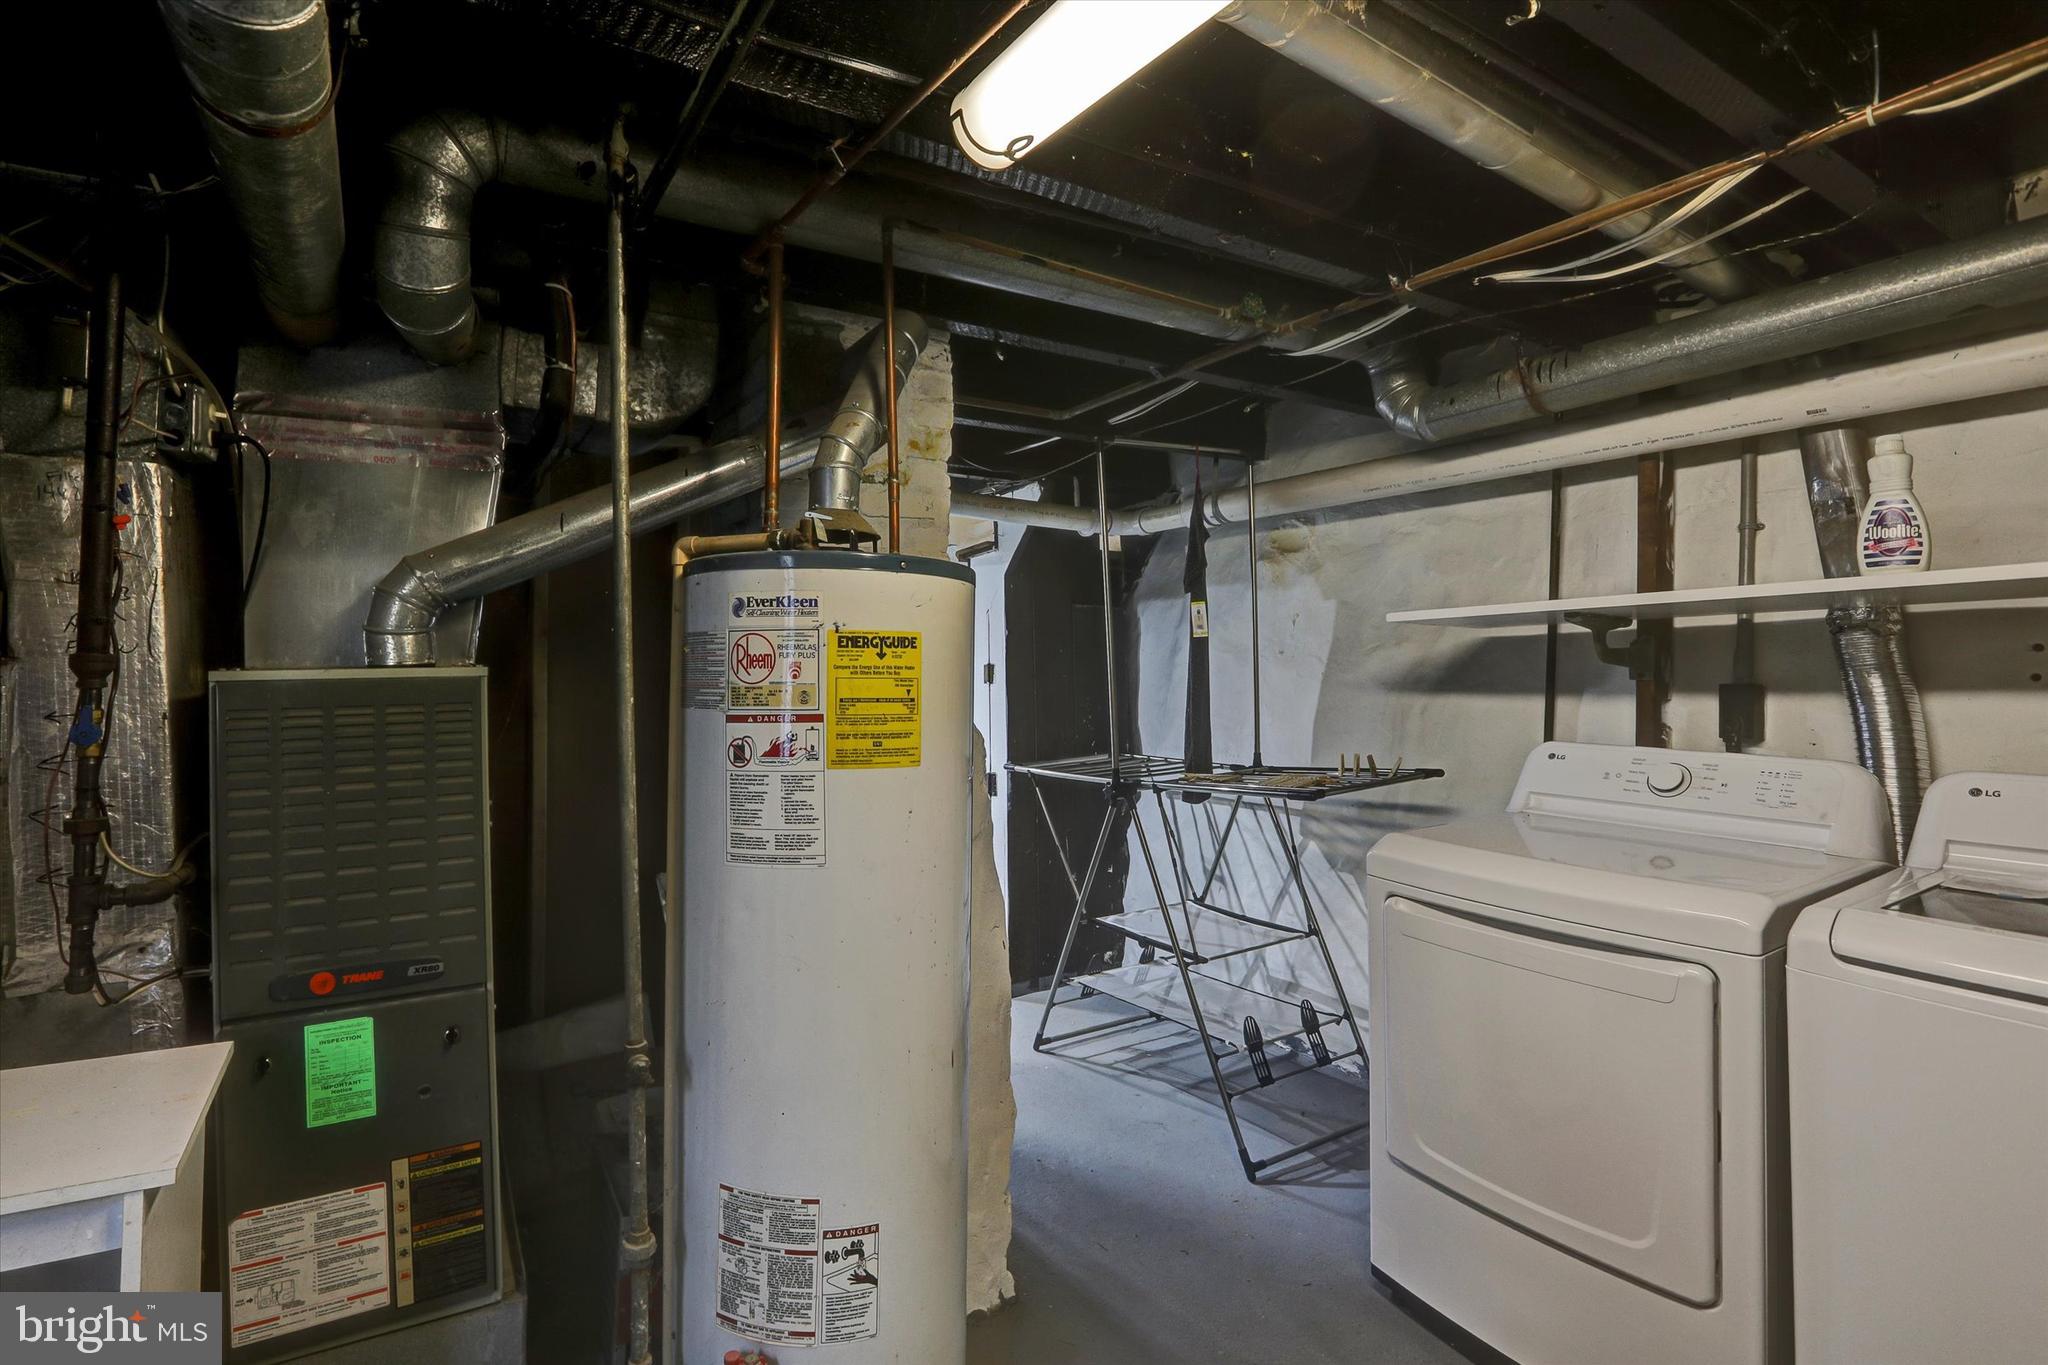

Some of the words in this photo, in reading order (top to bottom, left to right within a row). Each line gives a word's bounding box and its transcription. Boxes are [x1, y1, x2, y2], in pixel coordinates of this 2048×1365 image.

[373, 455, 396, 464] 04/20
[1868, 524, 1919, 540] Woolite
[746, 595, 818, 608] EverKleen
[736, 636, 772, 676] Rheem
[1985, 790, 2000, 798] LG
[342, 970, 384, 984] TRANE
[318, 1034, 362, 1046] INSPECTION
[320, 1080, 361, 1092] IMPORTANT
[835, 1226, 877, 1238] DANGER
